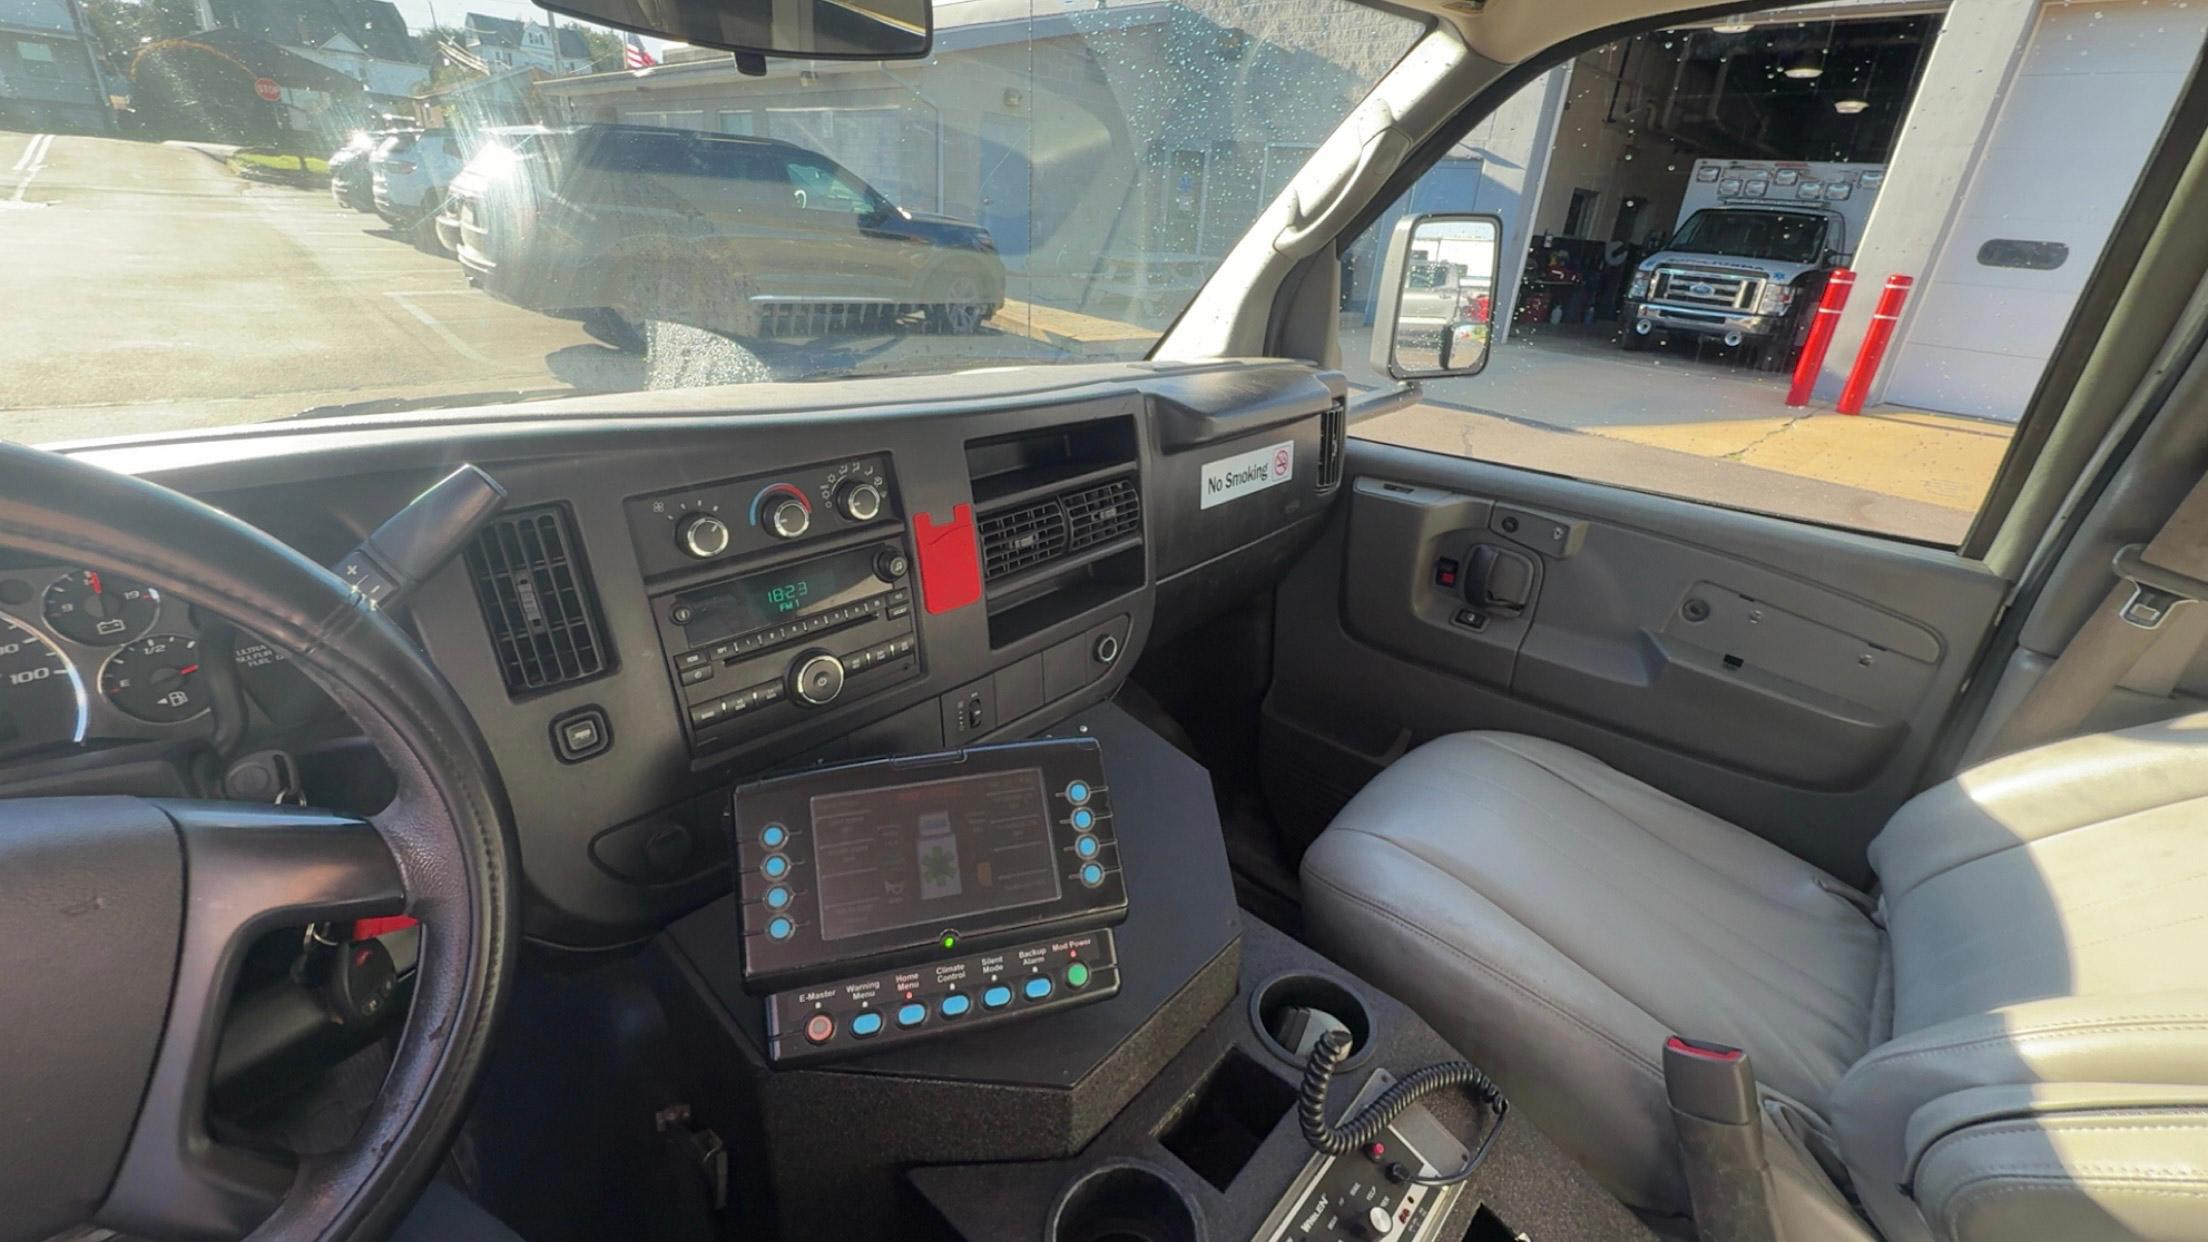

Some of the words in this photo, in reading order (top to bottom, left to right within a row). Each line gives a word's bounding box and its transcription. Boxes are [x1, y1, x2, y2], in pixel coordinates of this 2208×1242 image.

[1208, 476, 1223, 495] No
[1225, 463, 1268, 489] Smoking
[124, 590, 140, 600] 19
[10, 667, 49, 685] 100
[1069, 939, 1091, 948] Power
[1019, 948, 1047, 959] Backup
[982, 956, 1003, 966] Silent
[1023, 956, 1045, 966] Alarm
[936, 964, 965, 975] Climate
[983, 964, 1004, 974] Mode
[896, 972, 919, 983] Home
[937, 971, 966, 983] Control
[846, 981, 880, 993] Warning
[897, 981, 919, 991] Menu
[799, 990, 836, 1003] E-Master
[853, 991, 876, 1000] Menu
